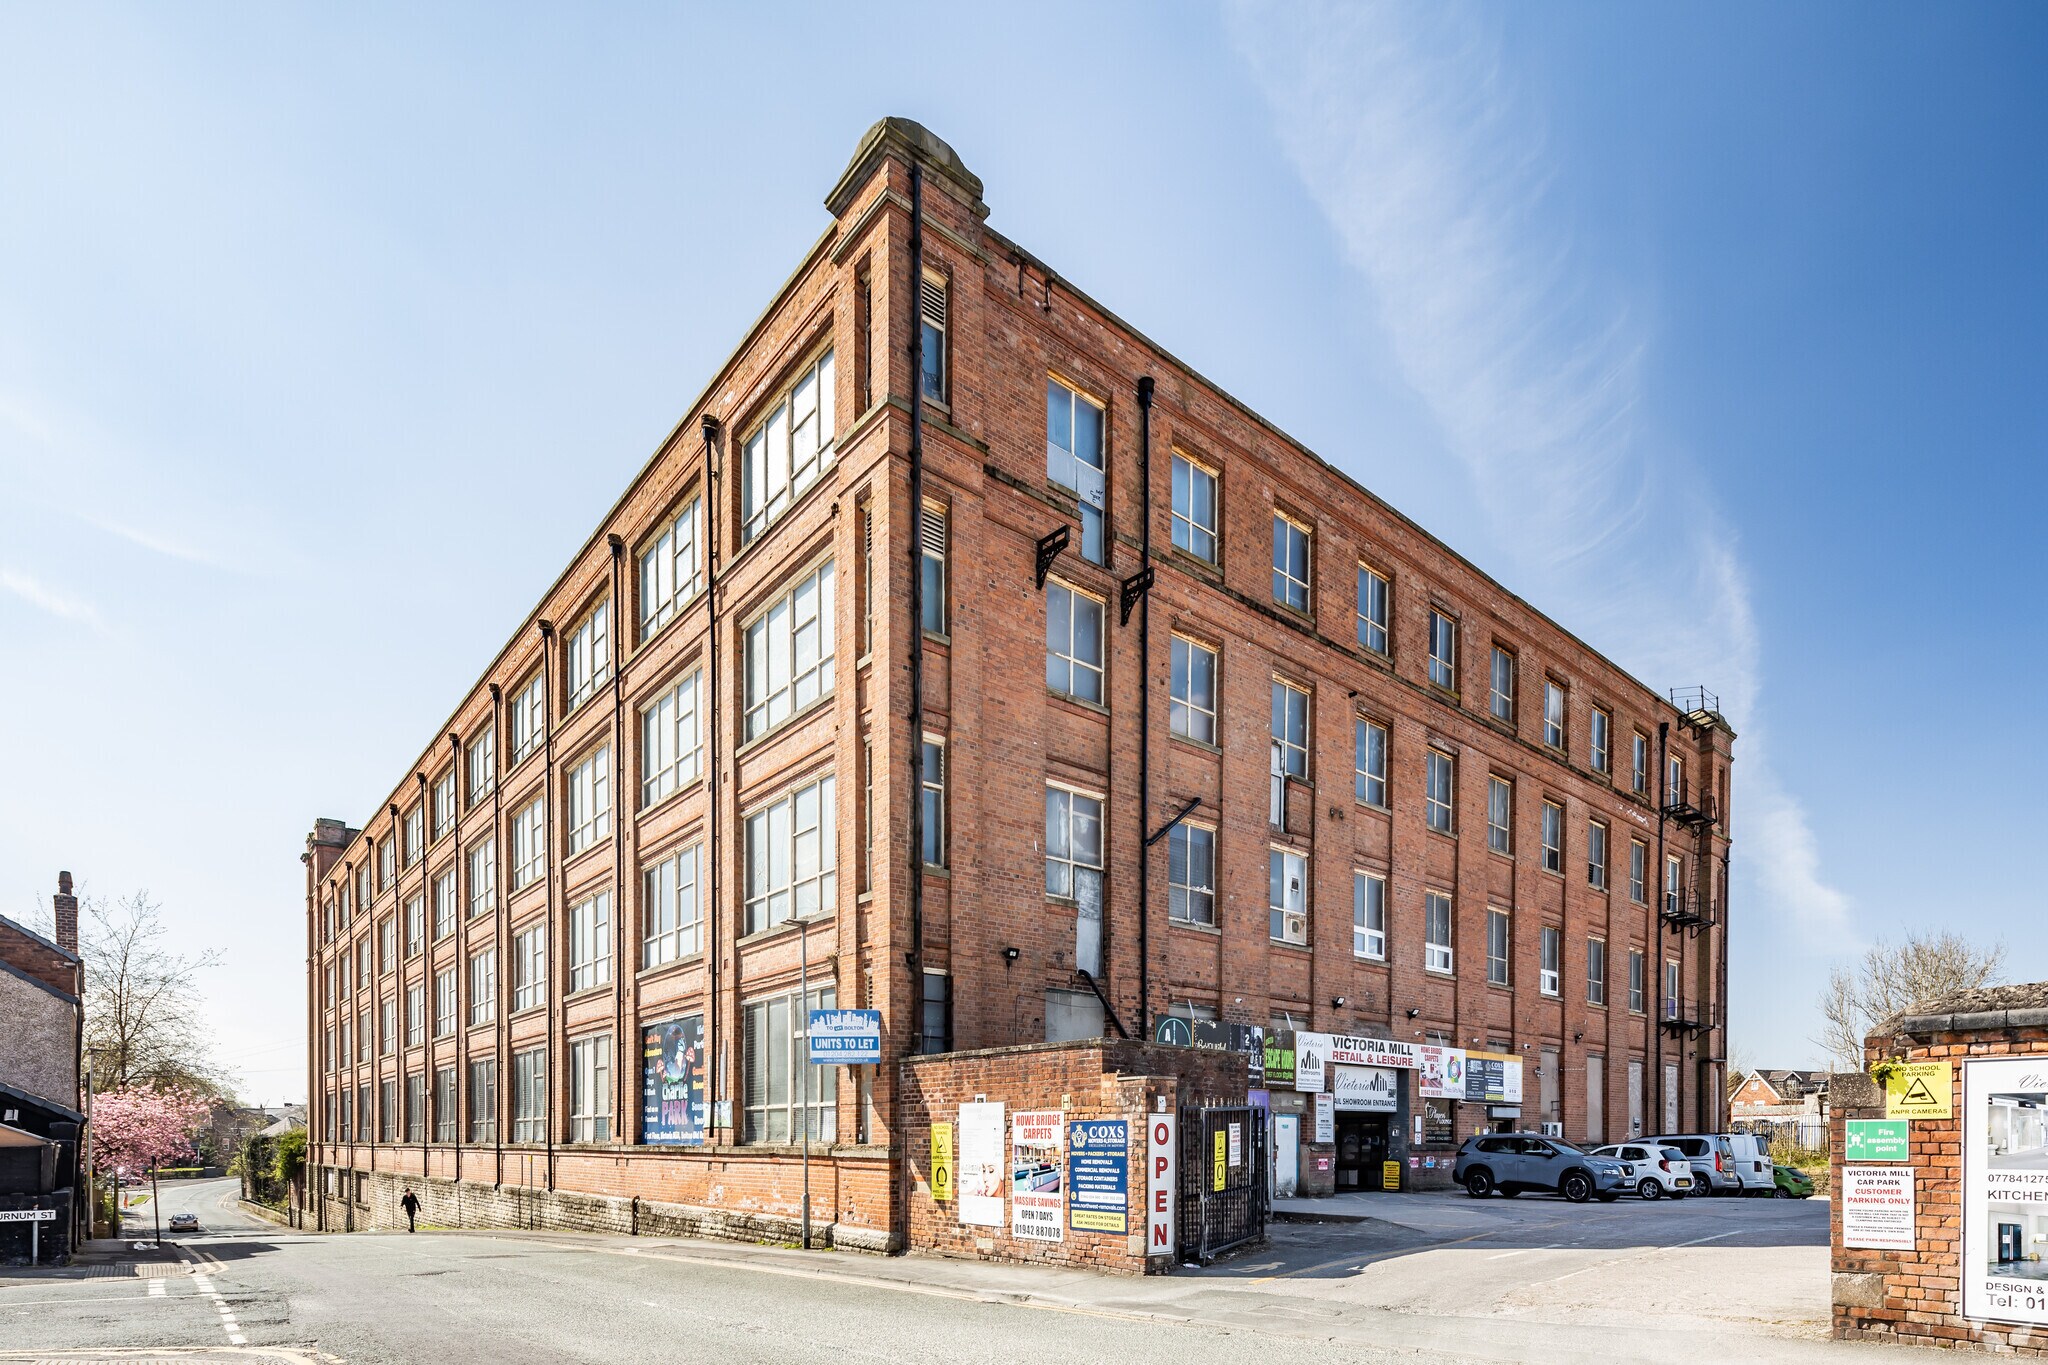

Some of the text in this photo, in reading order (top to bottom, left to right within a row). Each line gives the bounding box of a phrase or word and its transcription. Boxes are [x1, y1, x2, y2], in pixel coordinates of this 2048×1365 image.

[815, 1038, 874, 1049] UNITS TO LET
[1332, 1037, 1413, 1056] VICTORIA MILL
[1332, 1051, 1413, 1066] RETAIL & LEISURE
[1335, 1071, 1369, 1090] Victoria
[1370, 1072, 1387, 1091] Mill
[662, 1084, 688, 1100] Charlie
[1343, 1098, 1372, 1106] SHOWROOM
[662, 1100, 688, 1125] PARK
[1016, 1114, 1060, 1126] HOWE BRIDGE
[1024, 1128, 1052, 1139] CARPETS
[1089, 1126, 1124, 1138] COXS
[1867, 1137, 1905, 1145] assembly
[1154, 1123, 1169, 1246] OPEN
[1014, 1196, 1061, 1208] MASSIVE SAVINGS
[1022, 1210, 1053, 1221] OPEN 7 DAYS
[1015, 1224, 1060, 1238] 01942 887078
[1986, 1282, 2044, 1294] DESIGN &
[1986, 1293, 2045, 1310] Tel: 01
